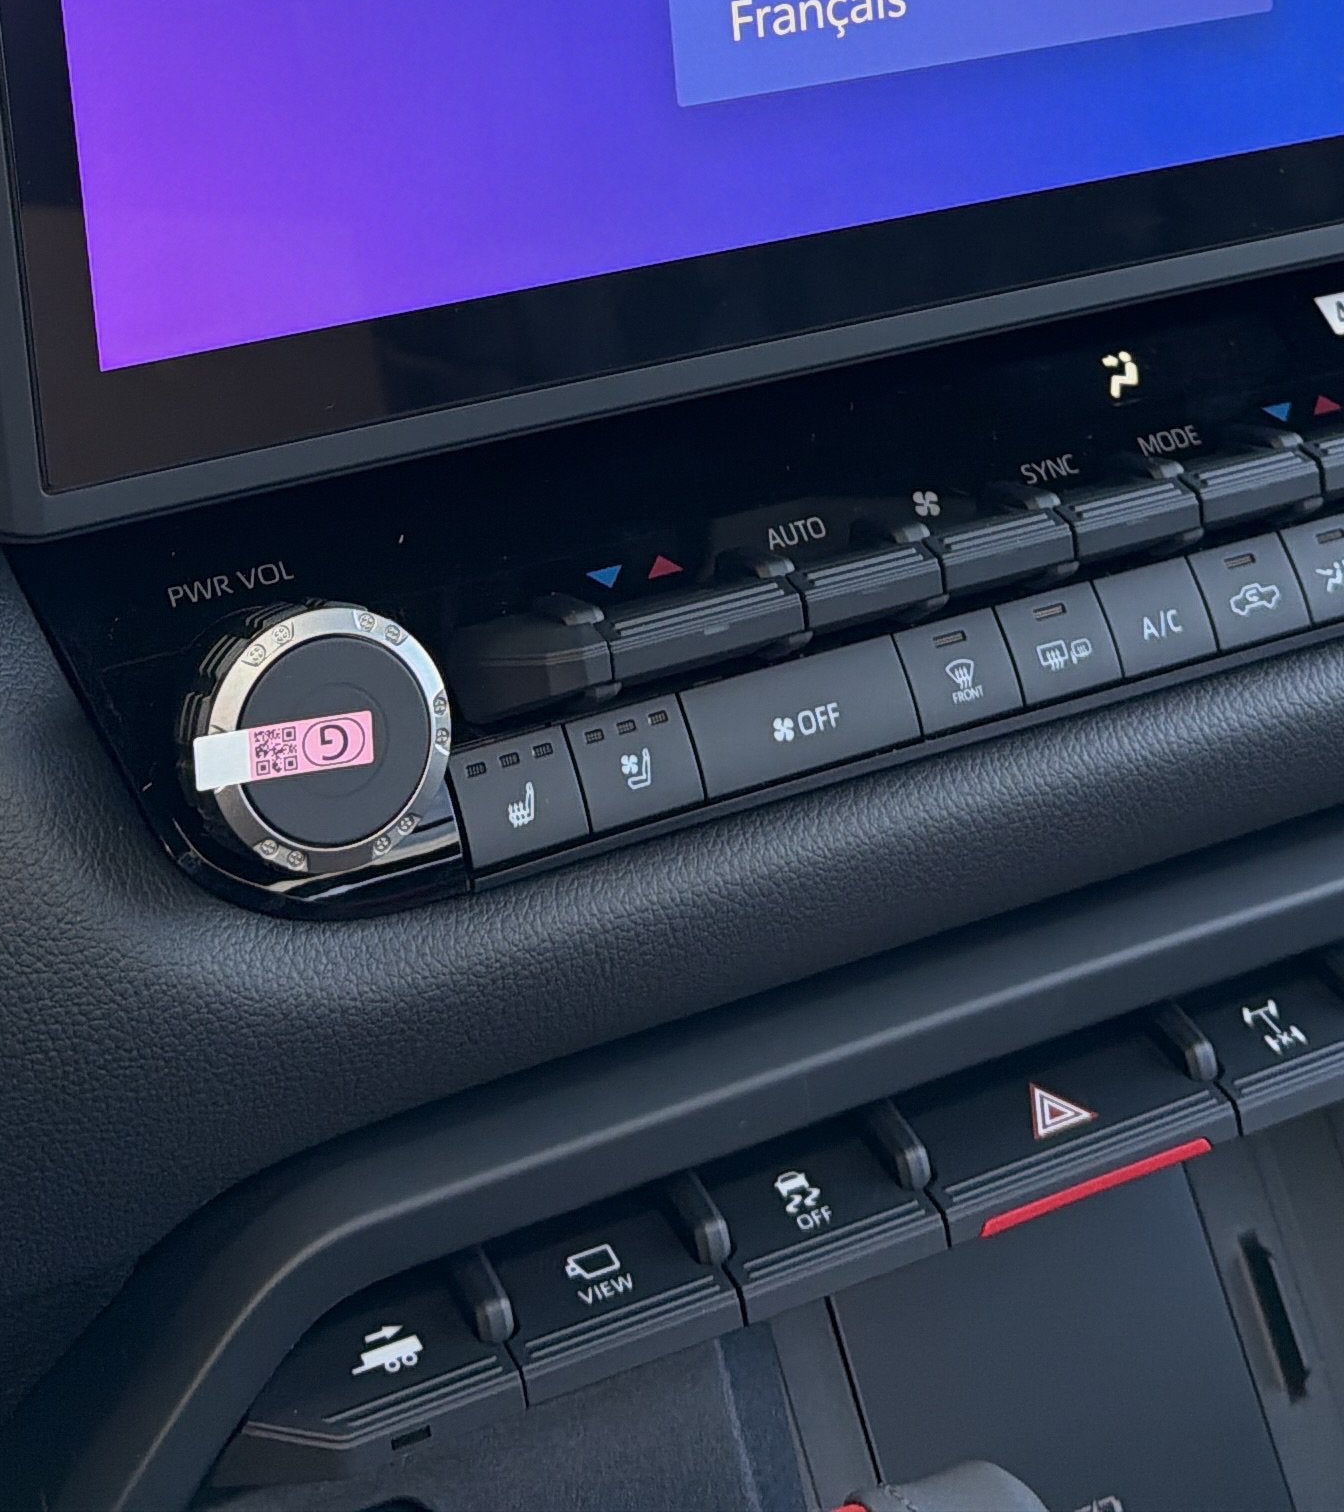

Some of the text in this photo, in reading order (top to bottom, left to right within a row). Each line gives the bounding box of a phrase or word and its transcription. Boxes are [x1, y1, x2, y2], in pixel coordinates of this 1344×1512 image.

[1137, 425, 1203, 458] MODE
[1020, 453, 1080, 485] SYNC
[767, 516, 826, 550] AUTO
[167, 560, 295, 608] PWR VOL
[1142, 609, 1183, 641] A/C
[952, 684, 984, 703] FRONT
[797, 702, 840, 736] OFF
[796, 1205, 833, 1230] OFF
[577, 1273, 634, 1305] VIEW
